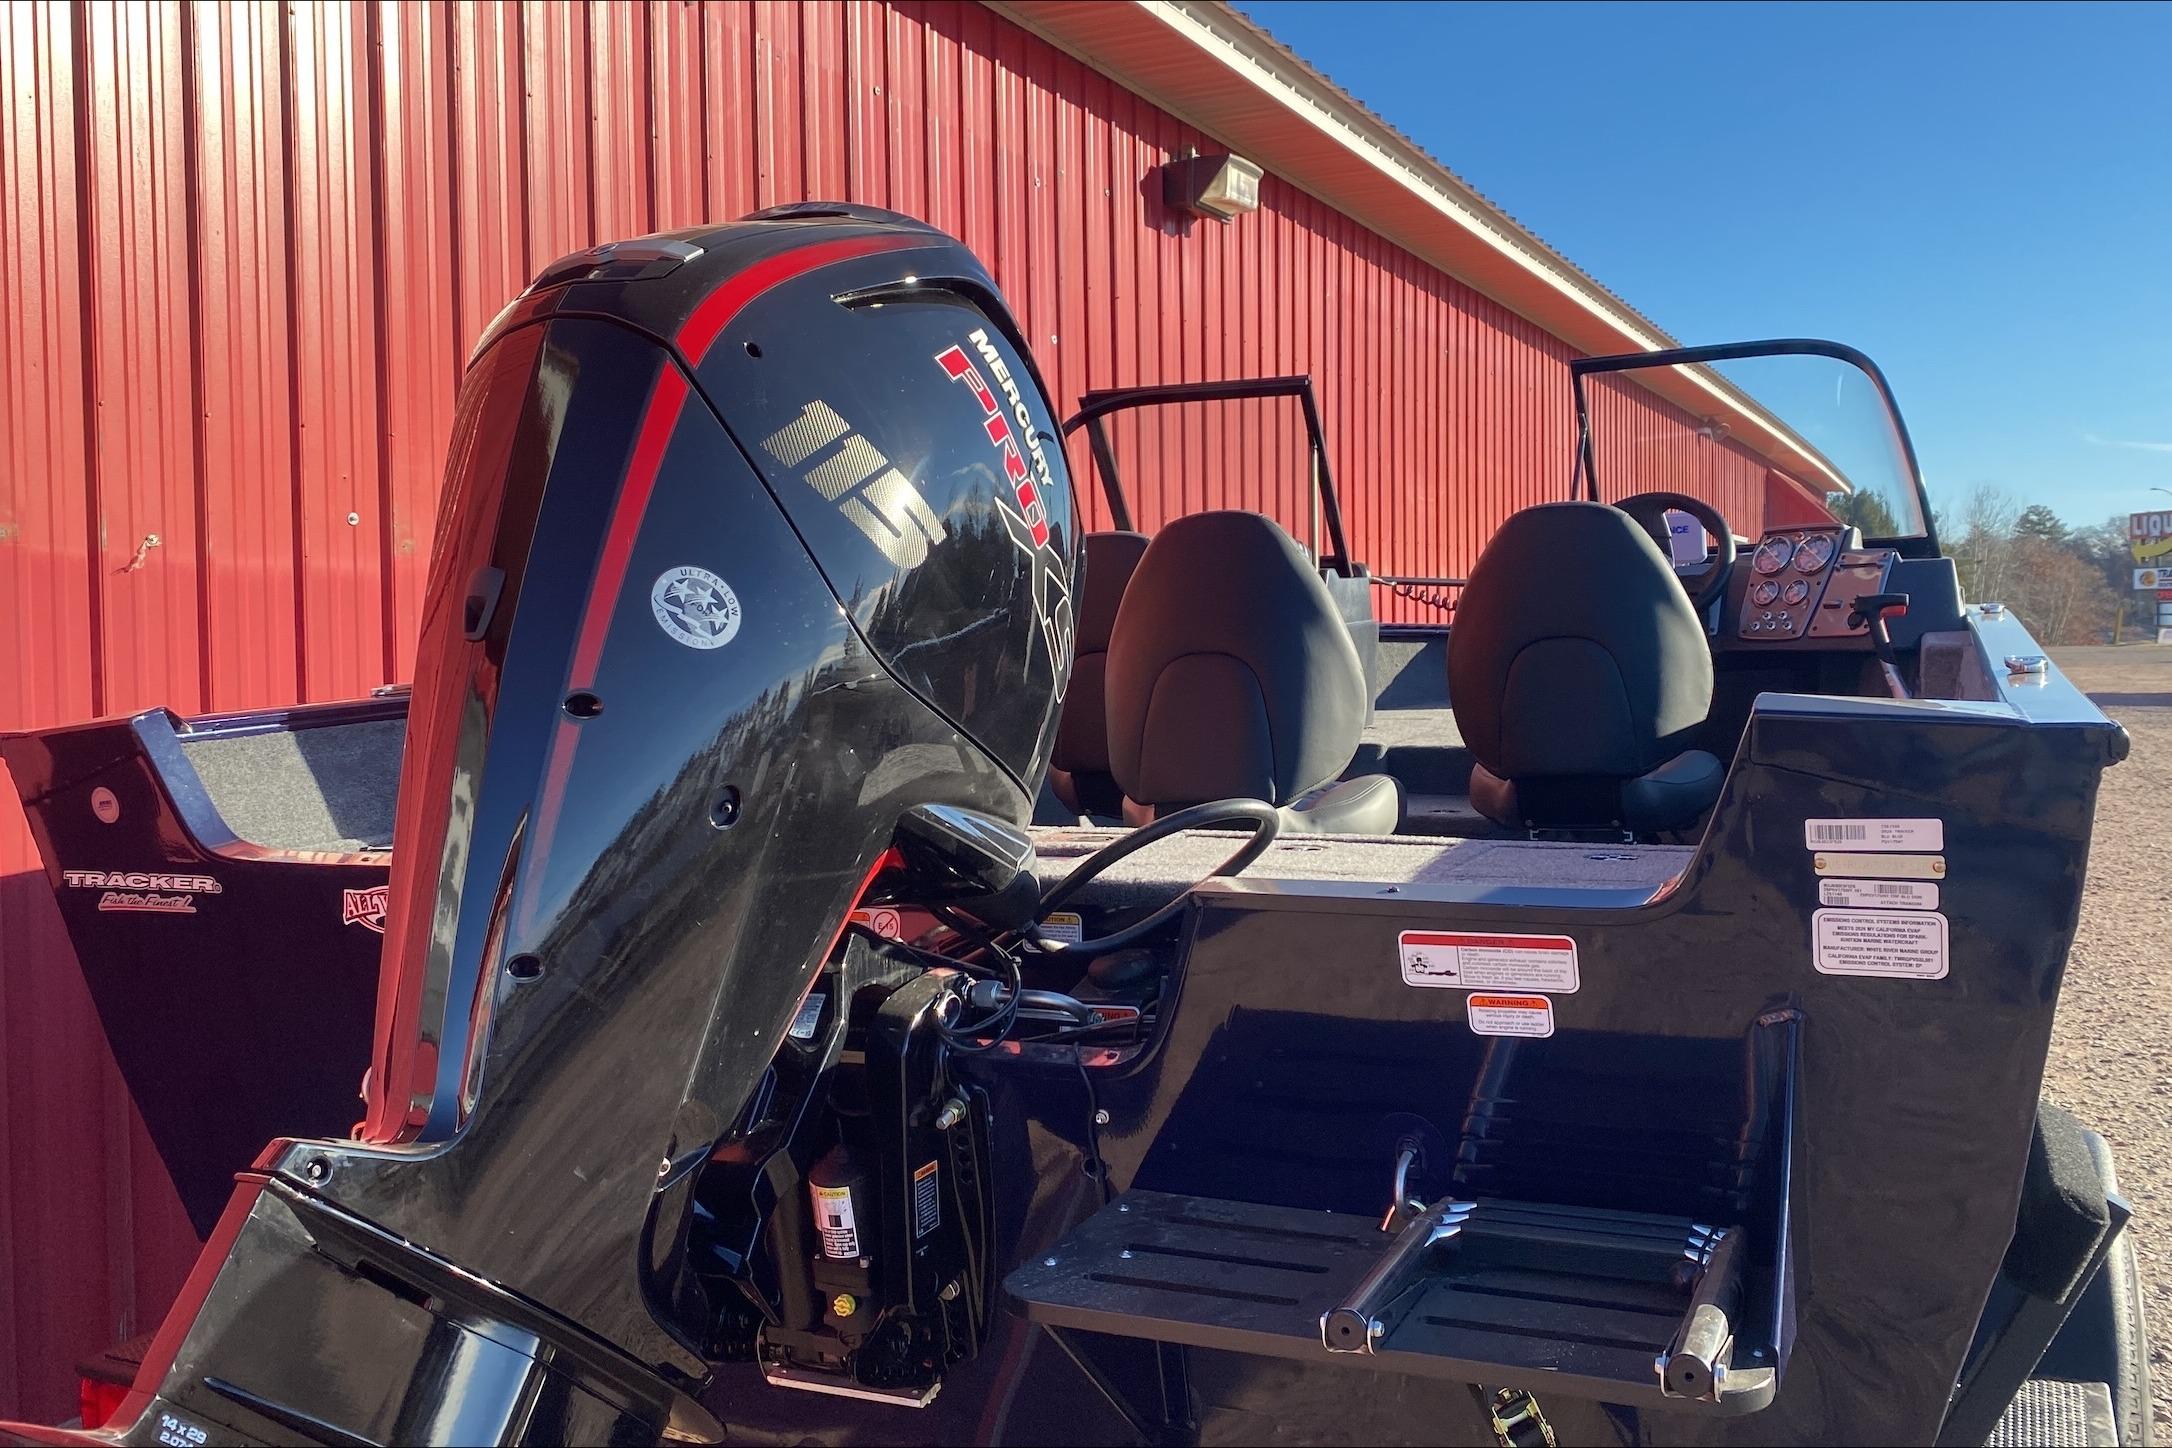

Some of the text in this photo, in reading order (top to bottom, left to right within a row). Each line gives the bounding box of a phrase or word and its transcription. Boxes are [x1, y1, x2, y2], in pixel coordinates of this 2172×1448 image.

[934, 344, 1050, 550] PRO
[968, 328, 1055, 487] MERCURY
[760, 399, 946, 570] 115
[65, 870, 217, 893] TRACKER
[103, 894, 124, 905] Fish
[127, 895, 143, 905] the
[162, 1414, 207, 1444] 14 x 29
